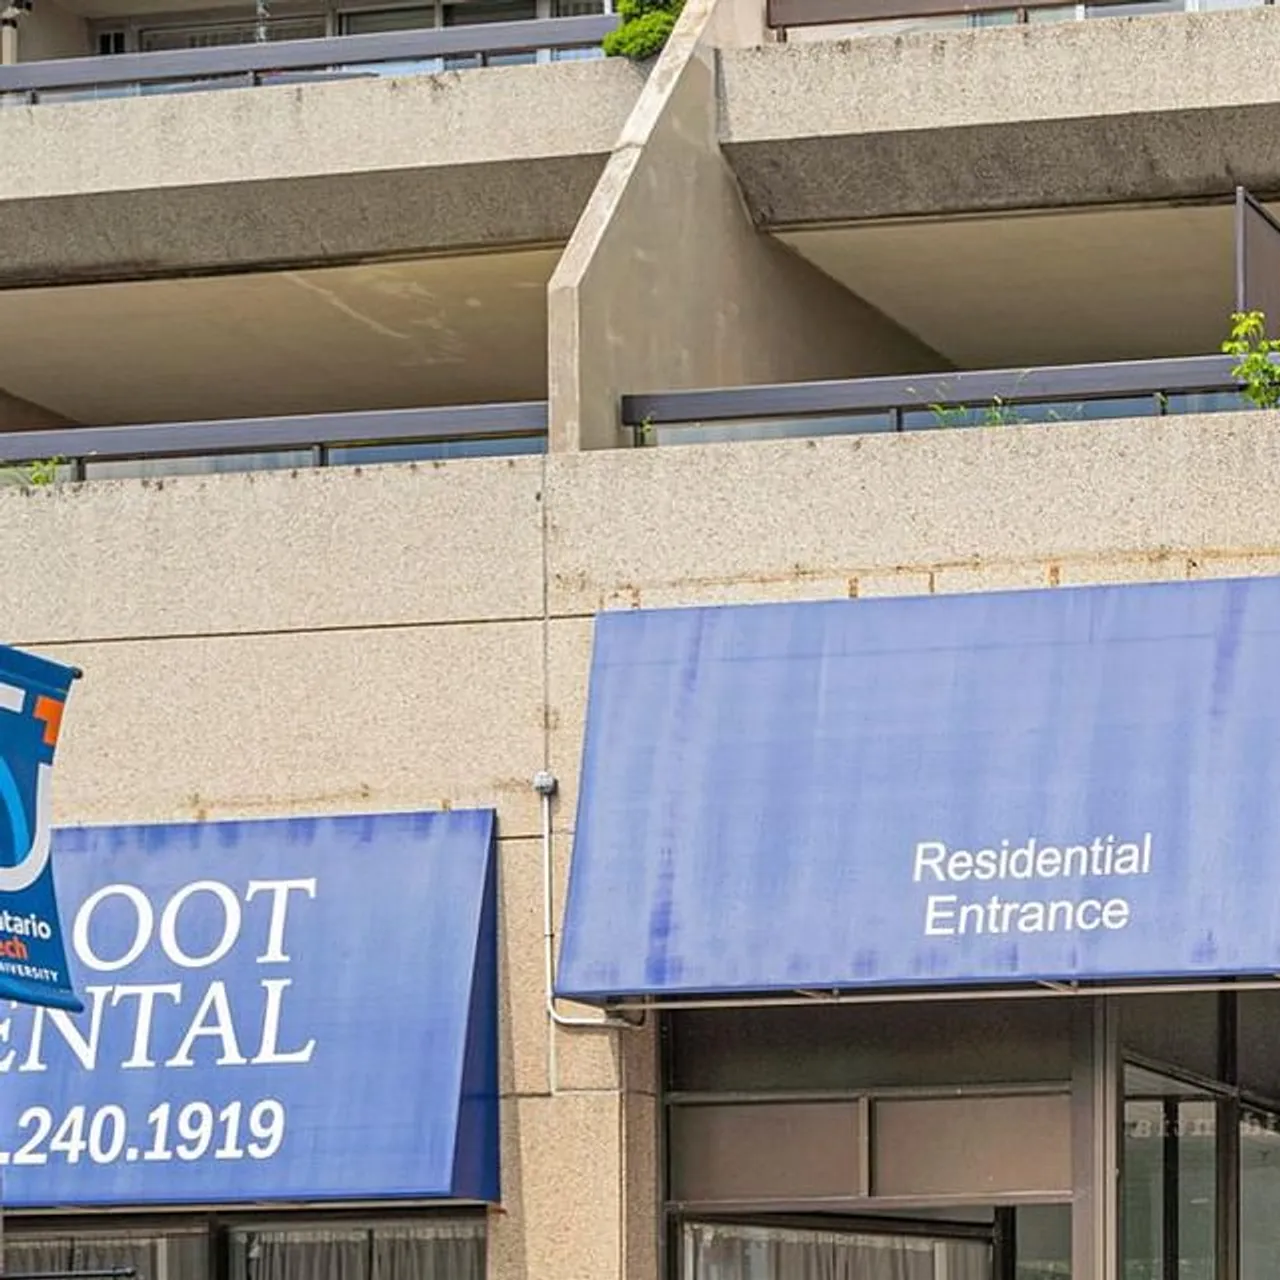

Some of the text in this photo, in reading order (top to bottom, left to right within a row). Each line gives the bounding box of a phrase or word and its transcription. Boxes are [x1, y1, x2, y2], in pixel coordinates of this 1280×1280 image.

[913, 832, 1153, 882] Residential
[73, 877, 317, 971] OOT
[924, 895, 1131, 936] Entrance
[0, 978, 317, 1073] NTAL
